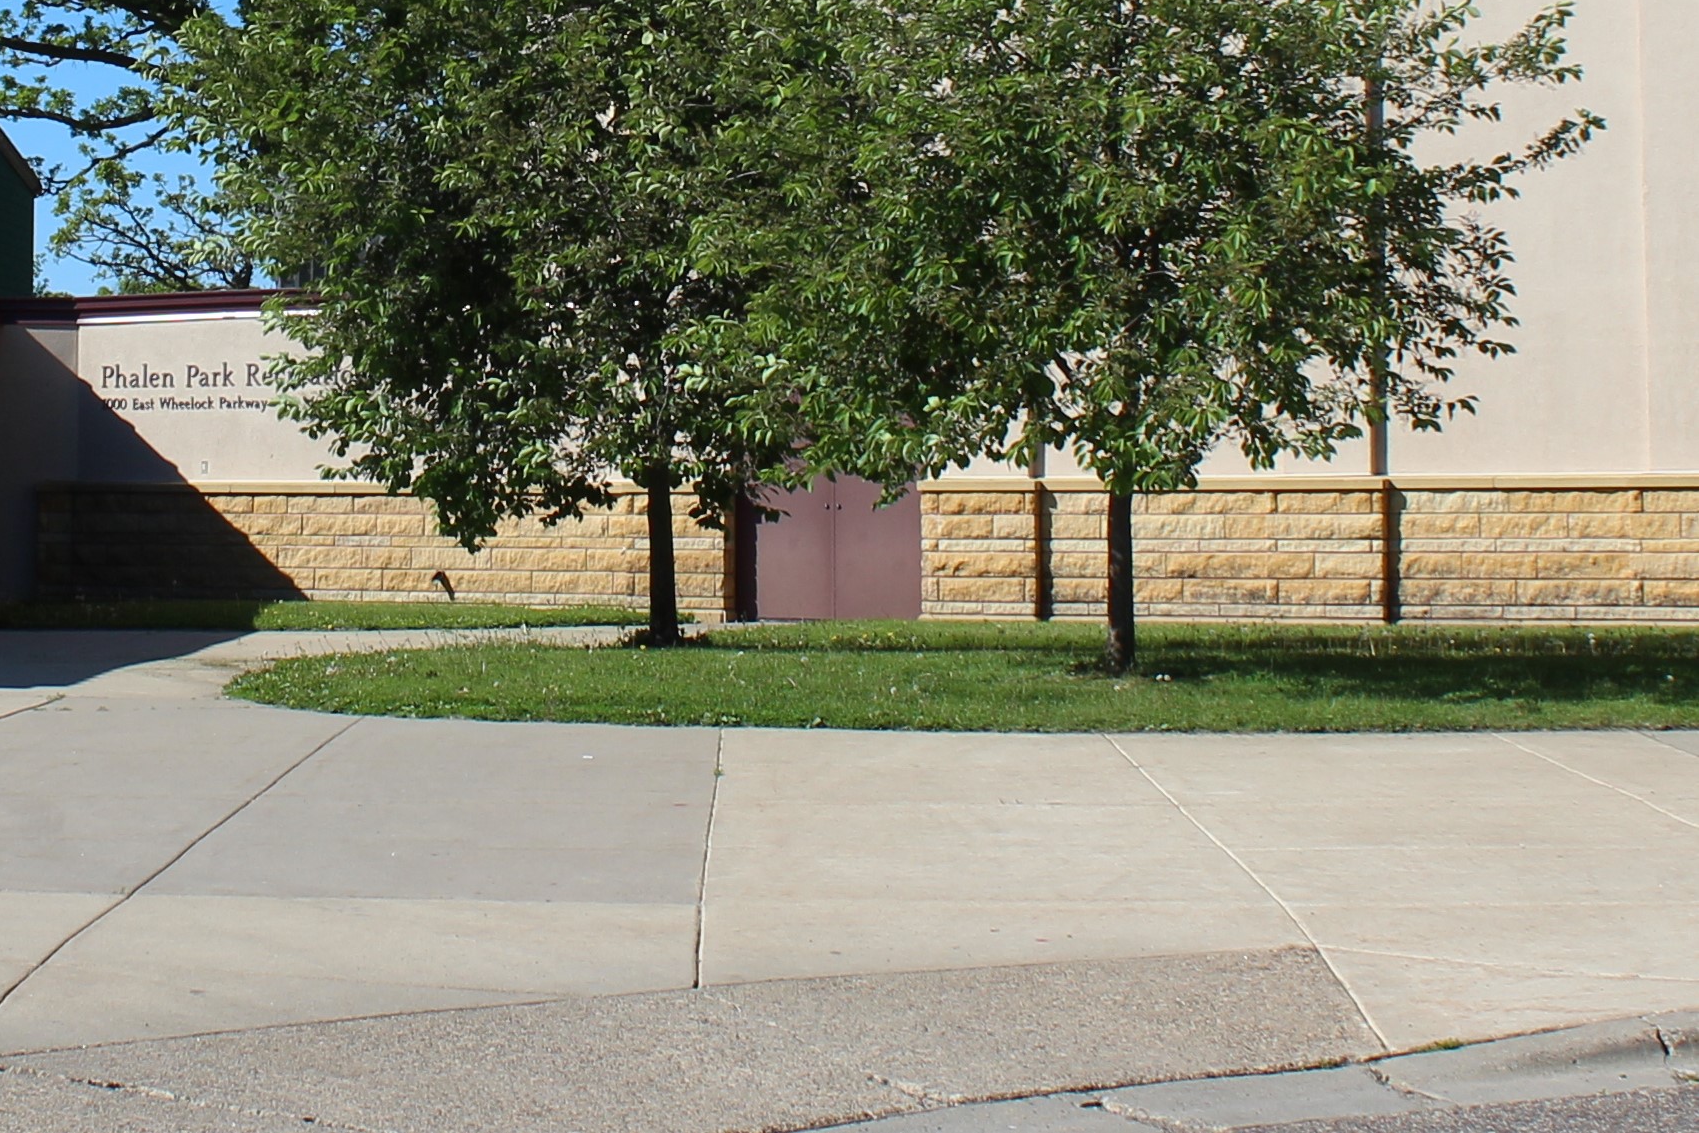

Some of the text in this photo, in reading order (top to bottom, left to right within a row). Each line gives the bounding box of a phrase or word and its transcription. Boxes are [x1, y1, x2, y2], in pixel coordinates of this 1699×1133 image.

[102, 363, 175, 389] Phalen
[186, 362, 235, 388] Park
[132, 398, 155, 411] East
[160, 396, 214, 411] Wheelock
[219, 395, 268, 413] Parkway
